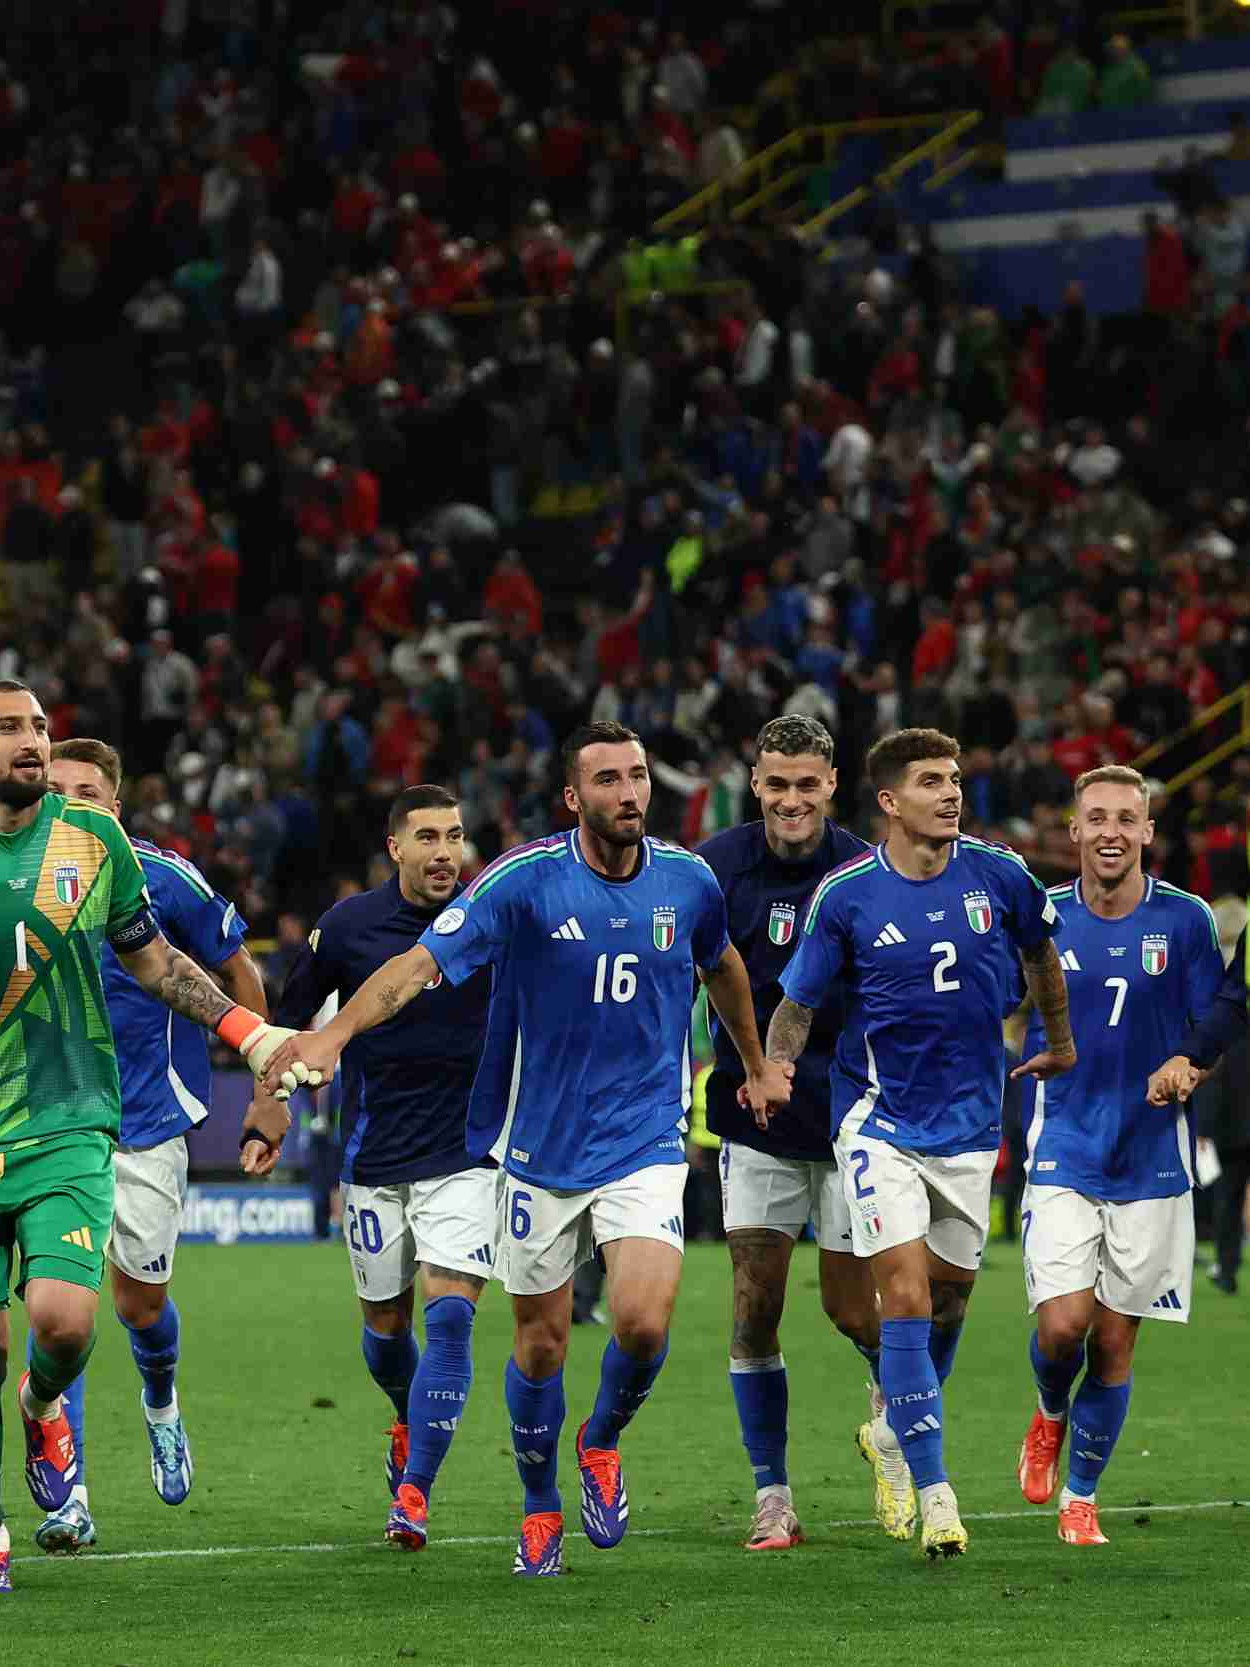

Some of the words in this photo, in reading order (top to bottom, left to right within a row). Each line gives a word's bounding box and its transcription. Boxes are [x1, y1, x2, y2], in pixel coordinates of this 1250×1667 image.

[15, 920, 28, 971] 1
[929, 942, 960, 993] 2
[593, 953, 638, 1004] 16
[1105, 978, 1128, 1027] 7
[851, 1149, 875, 1200] 2
[348, 1204, 383, 1254] 20
[504, 1185, 532, 1241] 6
